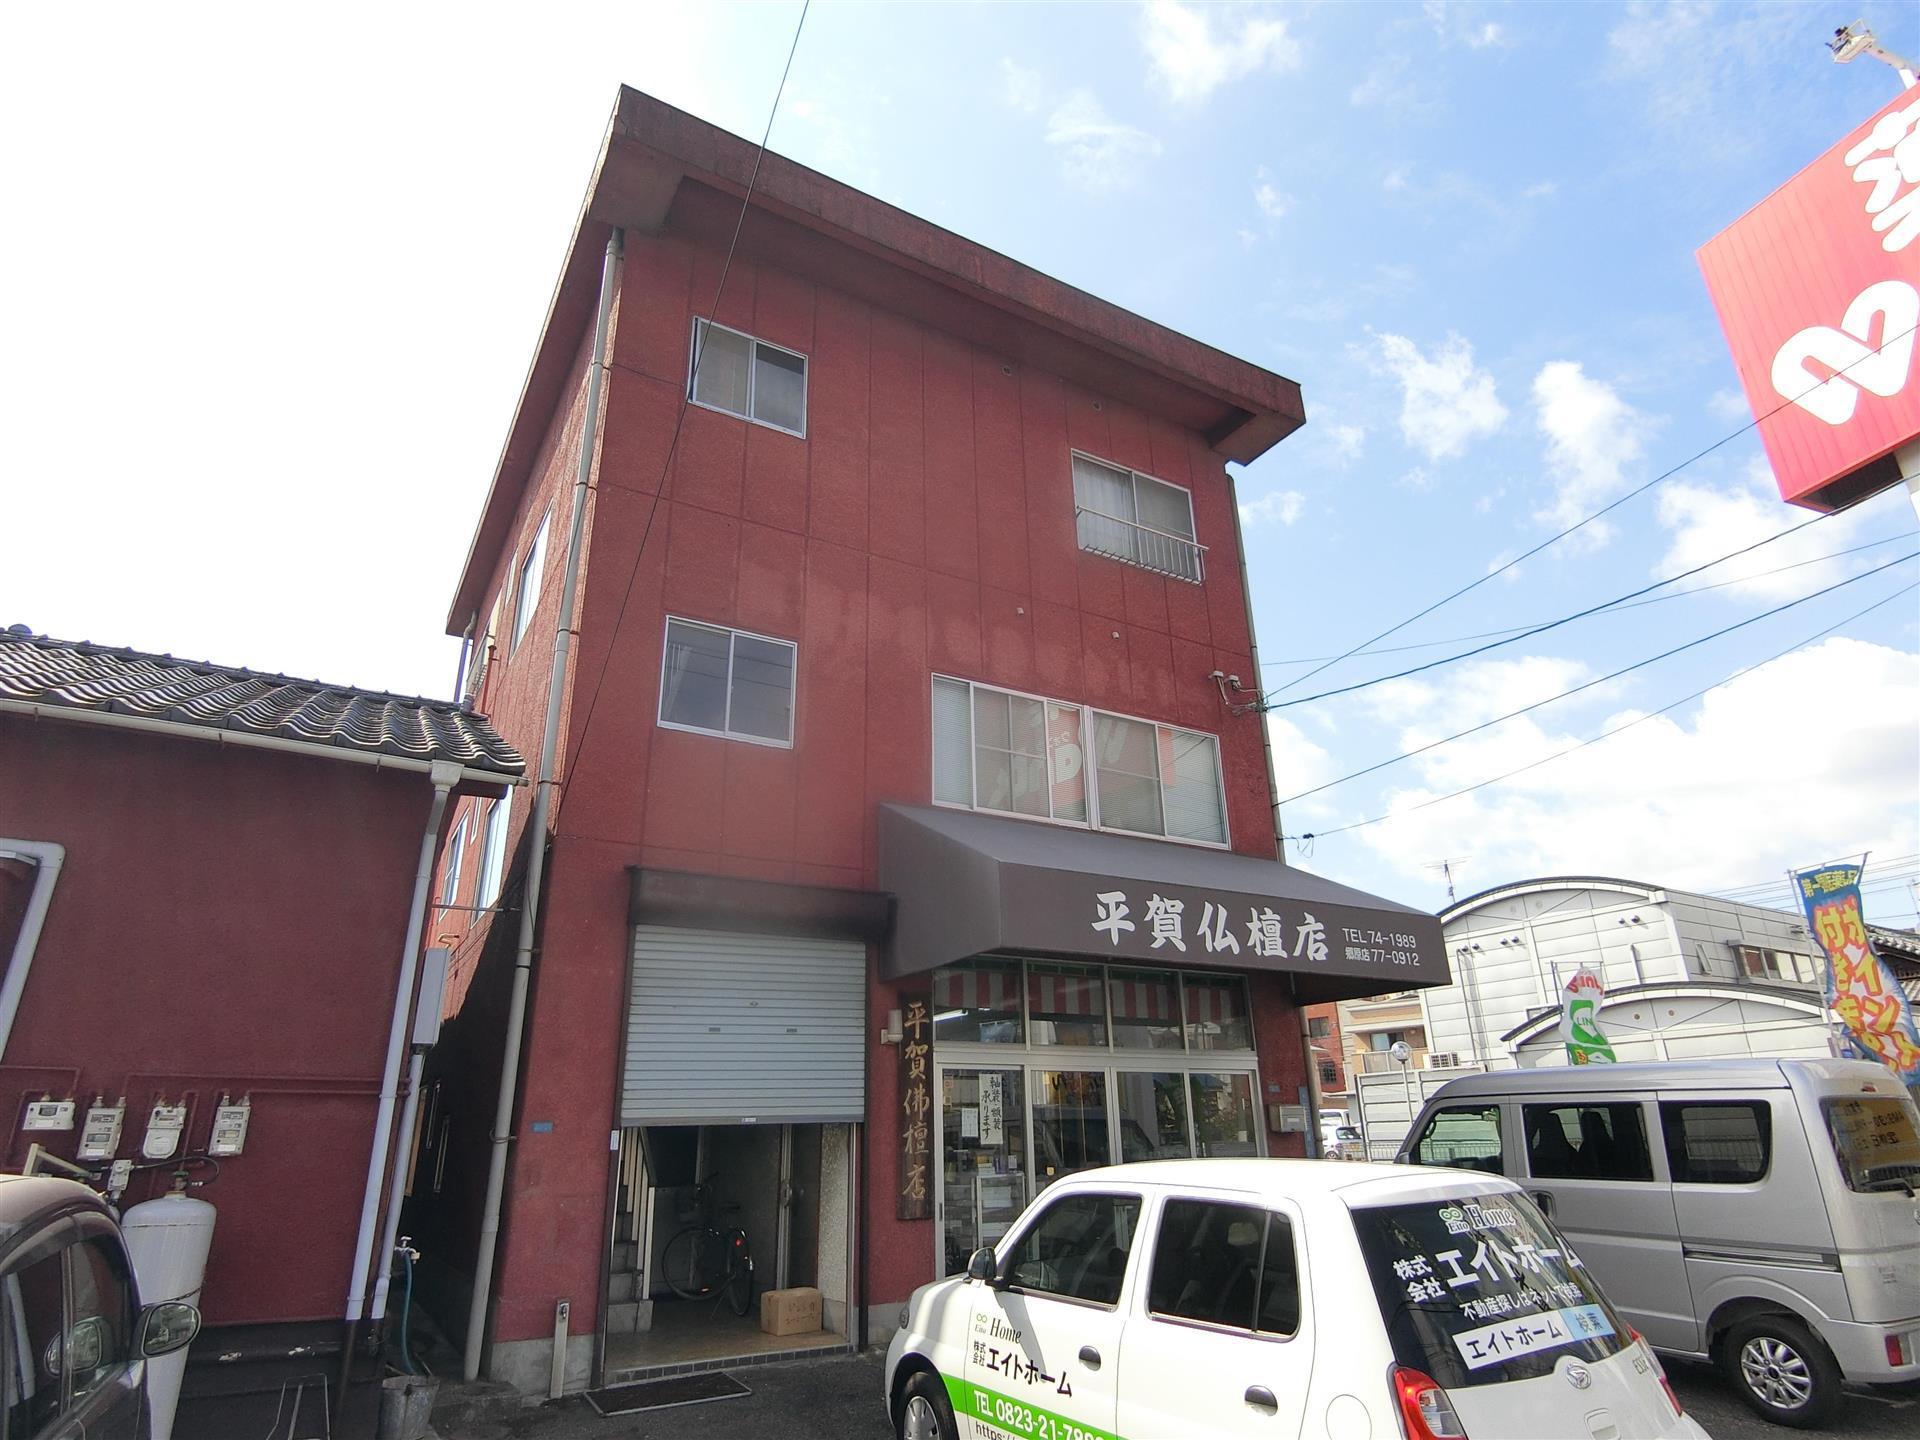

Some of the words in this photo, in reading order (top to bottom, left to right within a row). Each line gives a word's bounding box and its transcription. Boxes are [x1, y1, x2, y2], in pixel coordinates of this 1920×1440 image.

[1342, 928, 1367, 944] TEL
[1367, 930, 1416, 949] 74-1989
[1371, 949, 1421, 966] 77-0912
[981, 1090, 993, 1140] 承ります
[1463, 1203, 1517, 1230] Home
[1393, 1255, 1432, 1280] 株式
[1435, 1236, 1585, 1288] エイトホーム
[1406, 1278, 1447, 1303] 会社
[989, 1317, 1022, 1344] Home
[1465, 1321, 1563, 1359] エイトホーム
[986, 1347, 1073, 1398] エイトホーム
[973, 1390, 994, 1417] TEL
